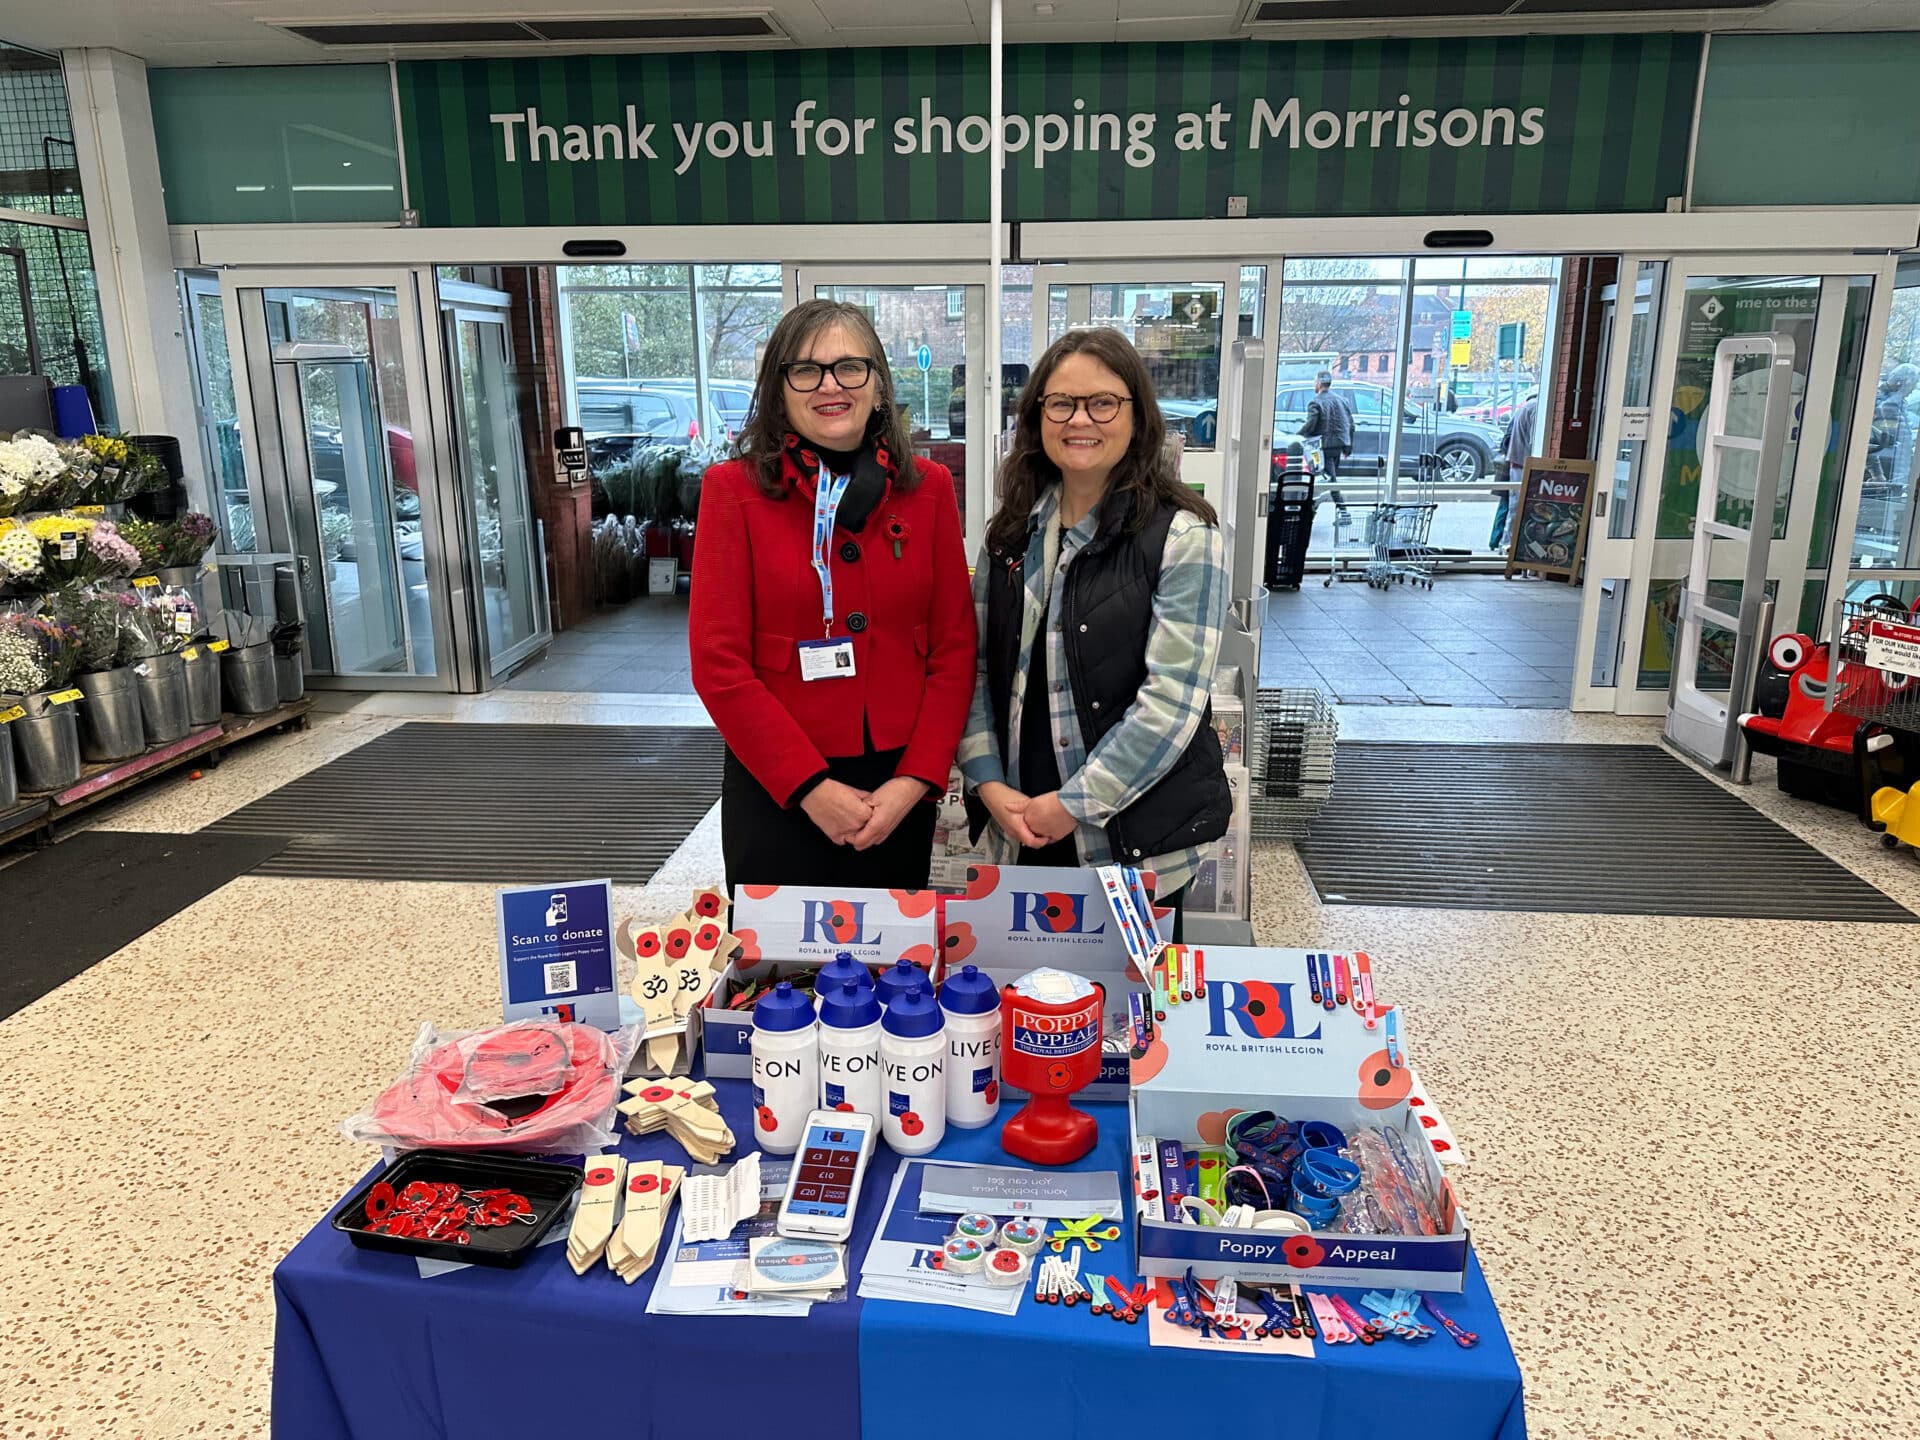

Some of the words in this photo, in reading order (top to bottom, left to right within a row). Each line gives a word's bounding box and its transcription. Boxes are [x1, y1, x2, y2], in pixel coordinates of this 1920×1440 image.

[490, 105, 658, 162] Thank
[672, 120, 774, 176] you
[791, 100, 876, 156] for
[893, 97, 1156, 169] shopping
[1175, 102, 1231, 151] at
[1249, 94, 1544, 150] Morrisons
[1539, 479, 1579, 497] New
[512, 934, 540, 946] Scan
[544, 934, 558, 943] to
[562, 929, 604, 940] donate
[1021, 1009, 1094, 1033] POPPY
[1020, 1026, 1095, 1046] APPEAL
[951, 1039, 991, 1058] LIVE
[1206, 1043, 1238, 1052] ROYAL
[1241, 1044, 1282, 1054] BRITISH
[1285, 1046, 1324, 1055] LEGION
[765, 1059, 801, 1078] ON
[846, 1051, 879, 1073] ON
[912, 1058, 943, 1082] ON
[818, 1171, 835, 1179] £10
[1169, 1177, 1180, 1193] Appeal
[1219, 1239, 1276, 1258] Poppy
[1330, 1245, 1396, 1265] Appeal
[1238, 1270, 1270, 1278] Supporting
